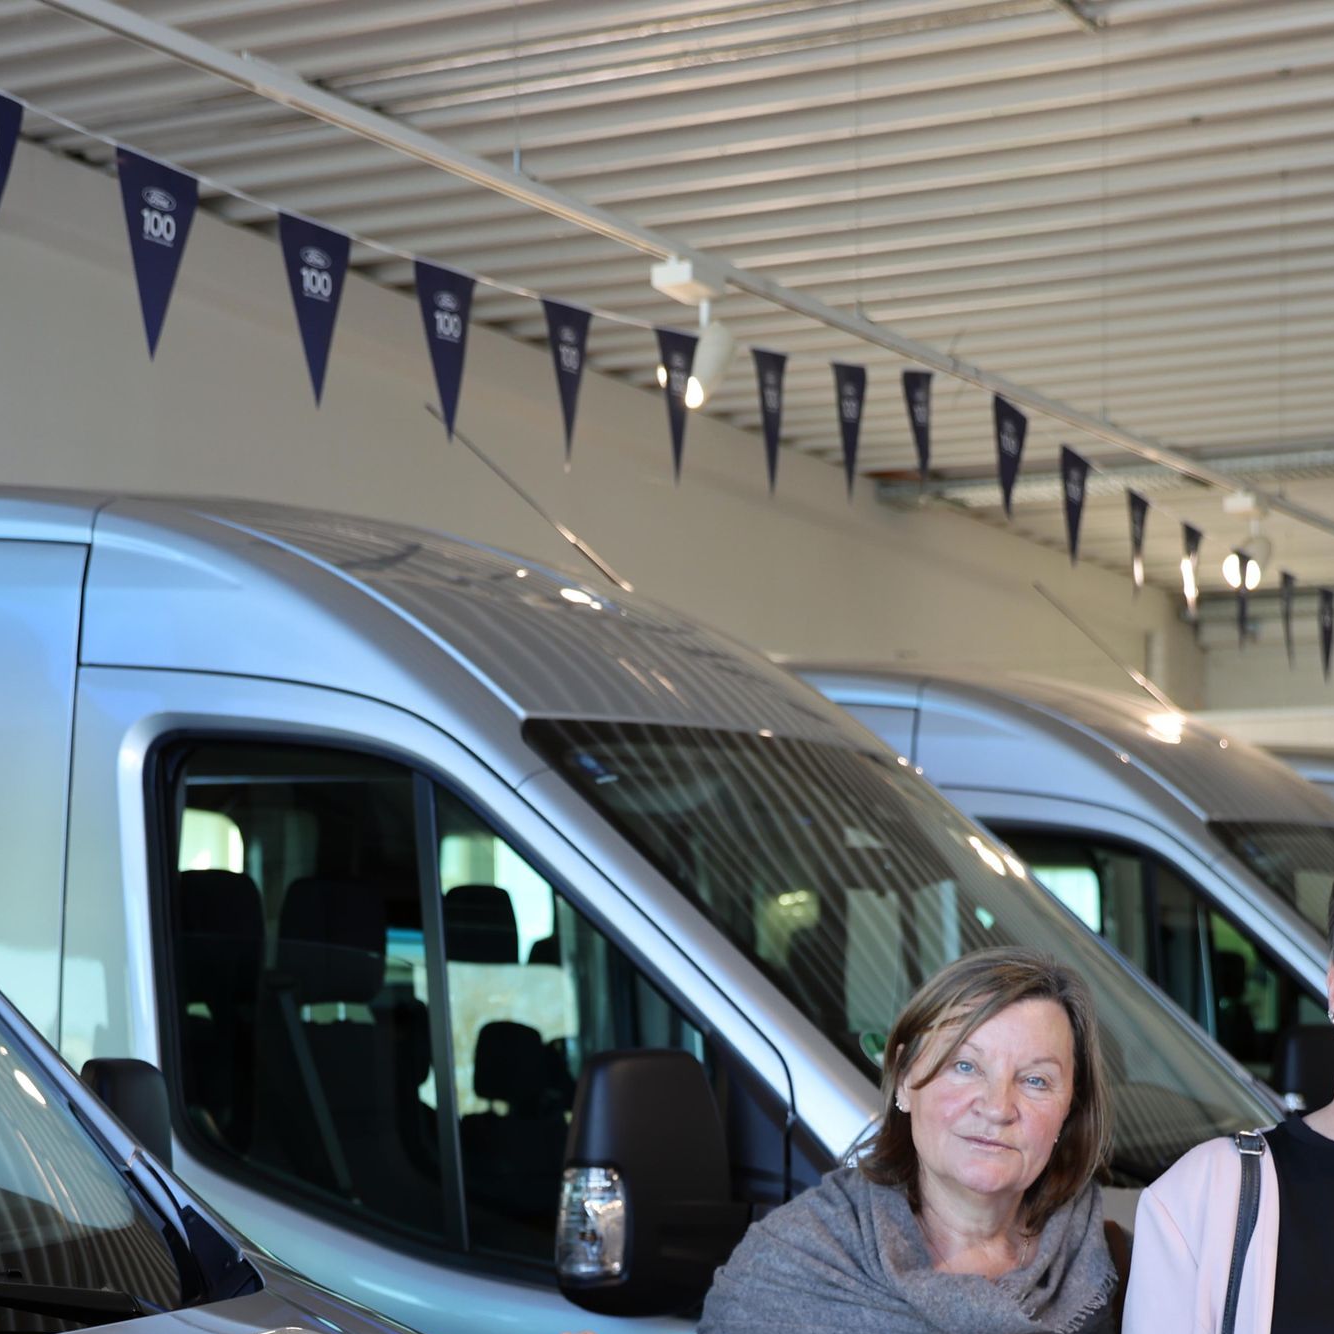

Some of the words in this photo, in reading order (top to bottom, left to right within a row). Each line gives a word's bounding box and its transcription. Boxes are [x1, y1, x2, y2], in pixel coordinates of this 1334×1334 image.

[141, 208, 176, 241] 100
[300, 267, 333, 297] 100
[434, 311, 462, 338] 100
